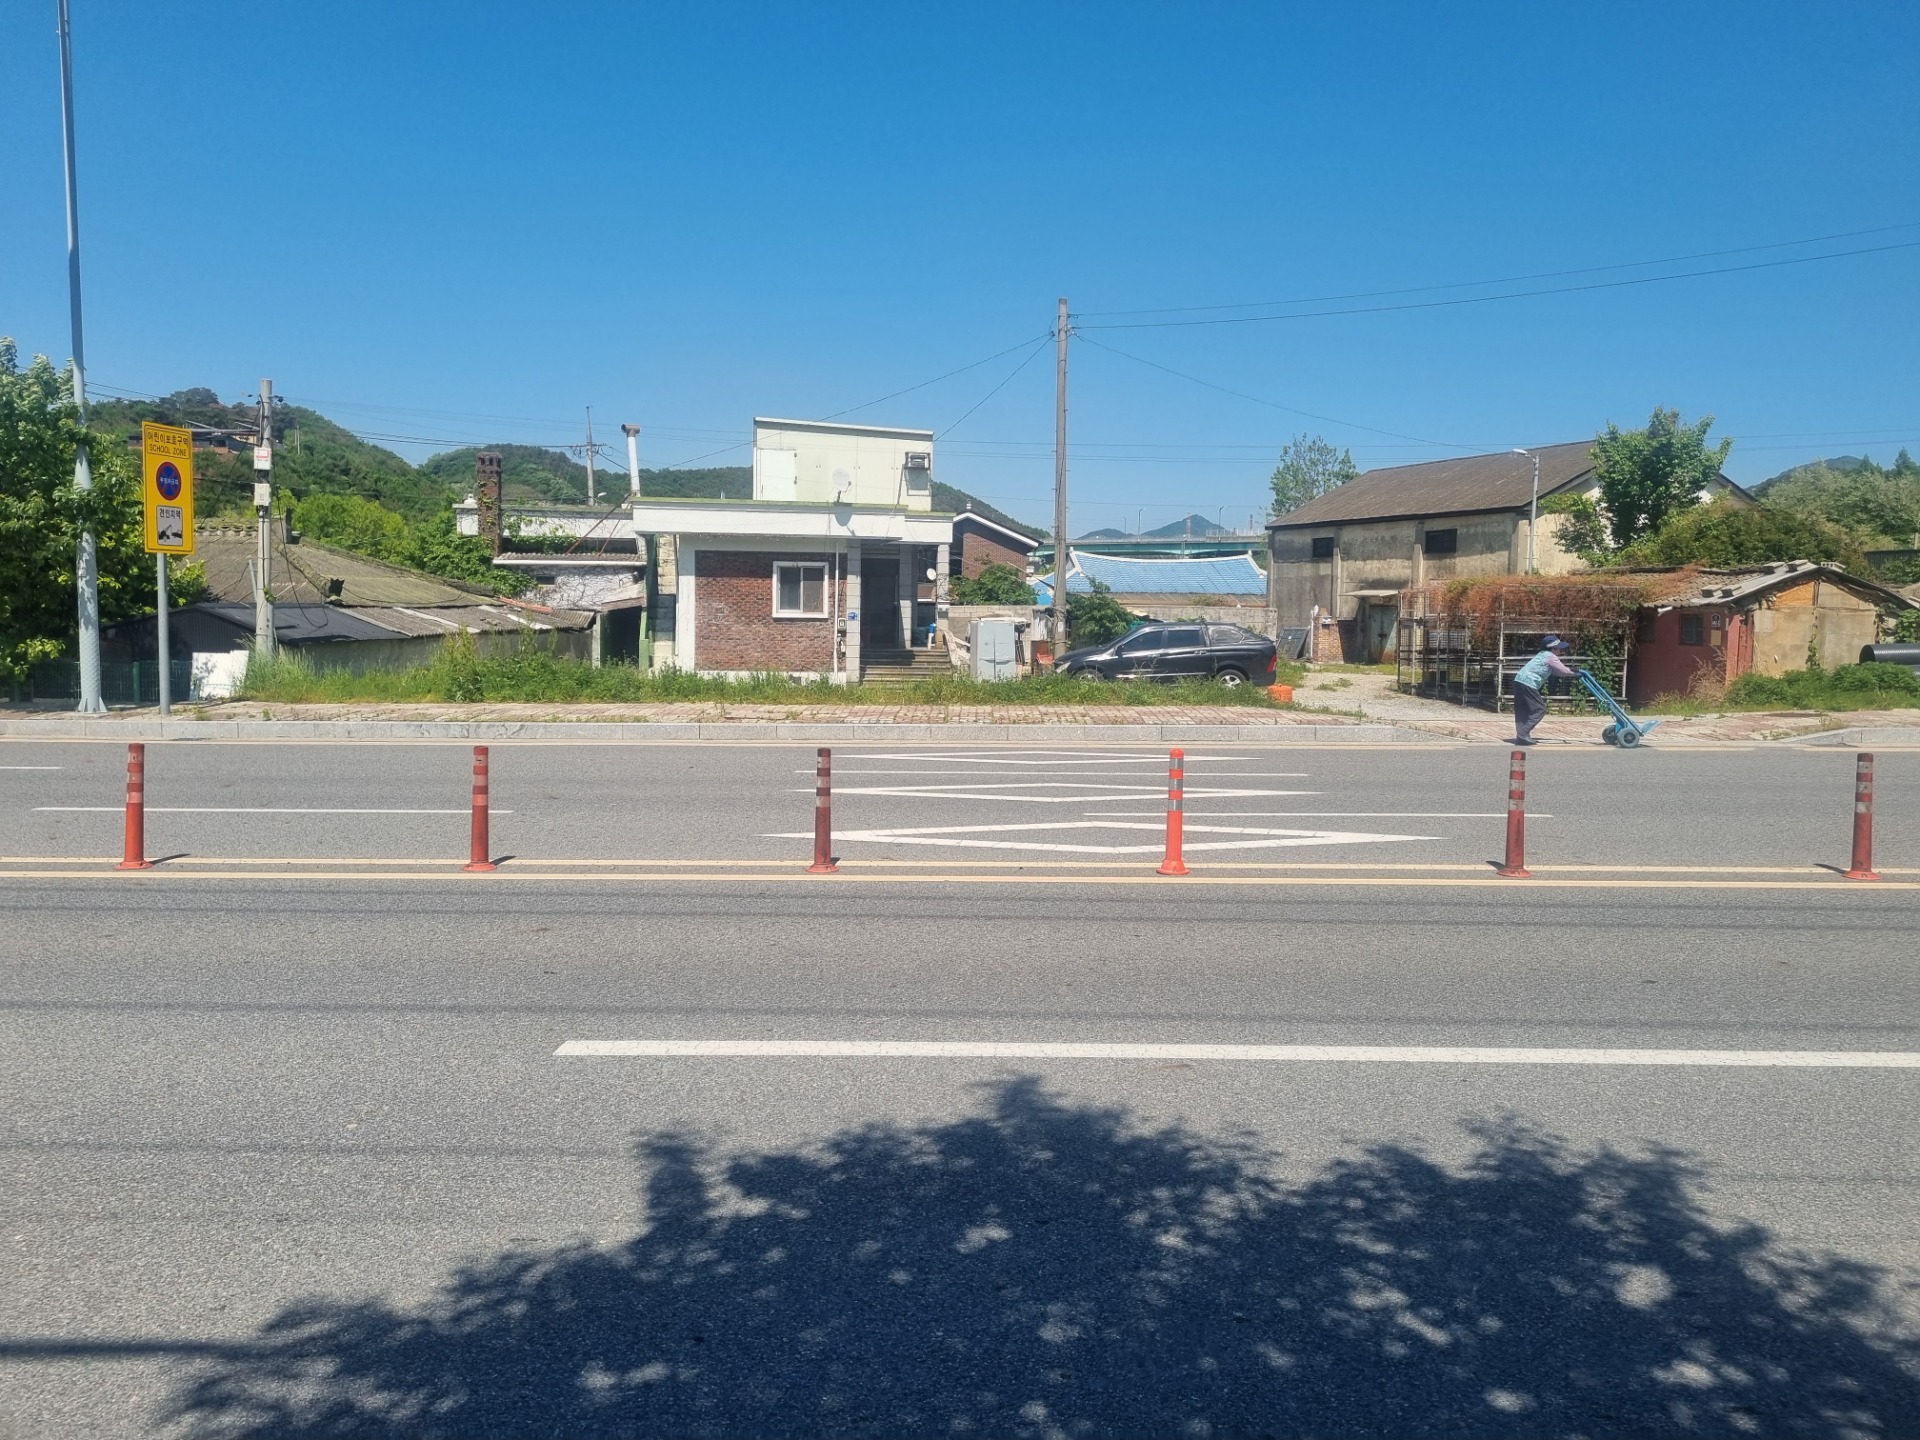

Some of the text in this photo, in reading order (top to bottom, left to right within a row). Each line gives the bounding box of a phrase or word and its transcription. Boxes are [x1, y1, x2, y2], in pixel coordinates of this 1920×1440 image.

[147, 431, 190, 447] 어린이보호구역
[149, 443, 187, 457] SCHOOL ZONE
[159, 508, 181, 519] 견인지역
